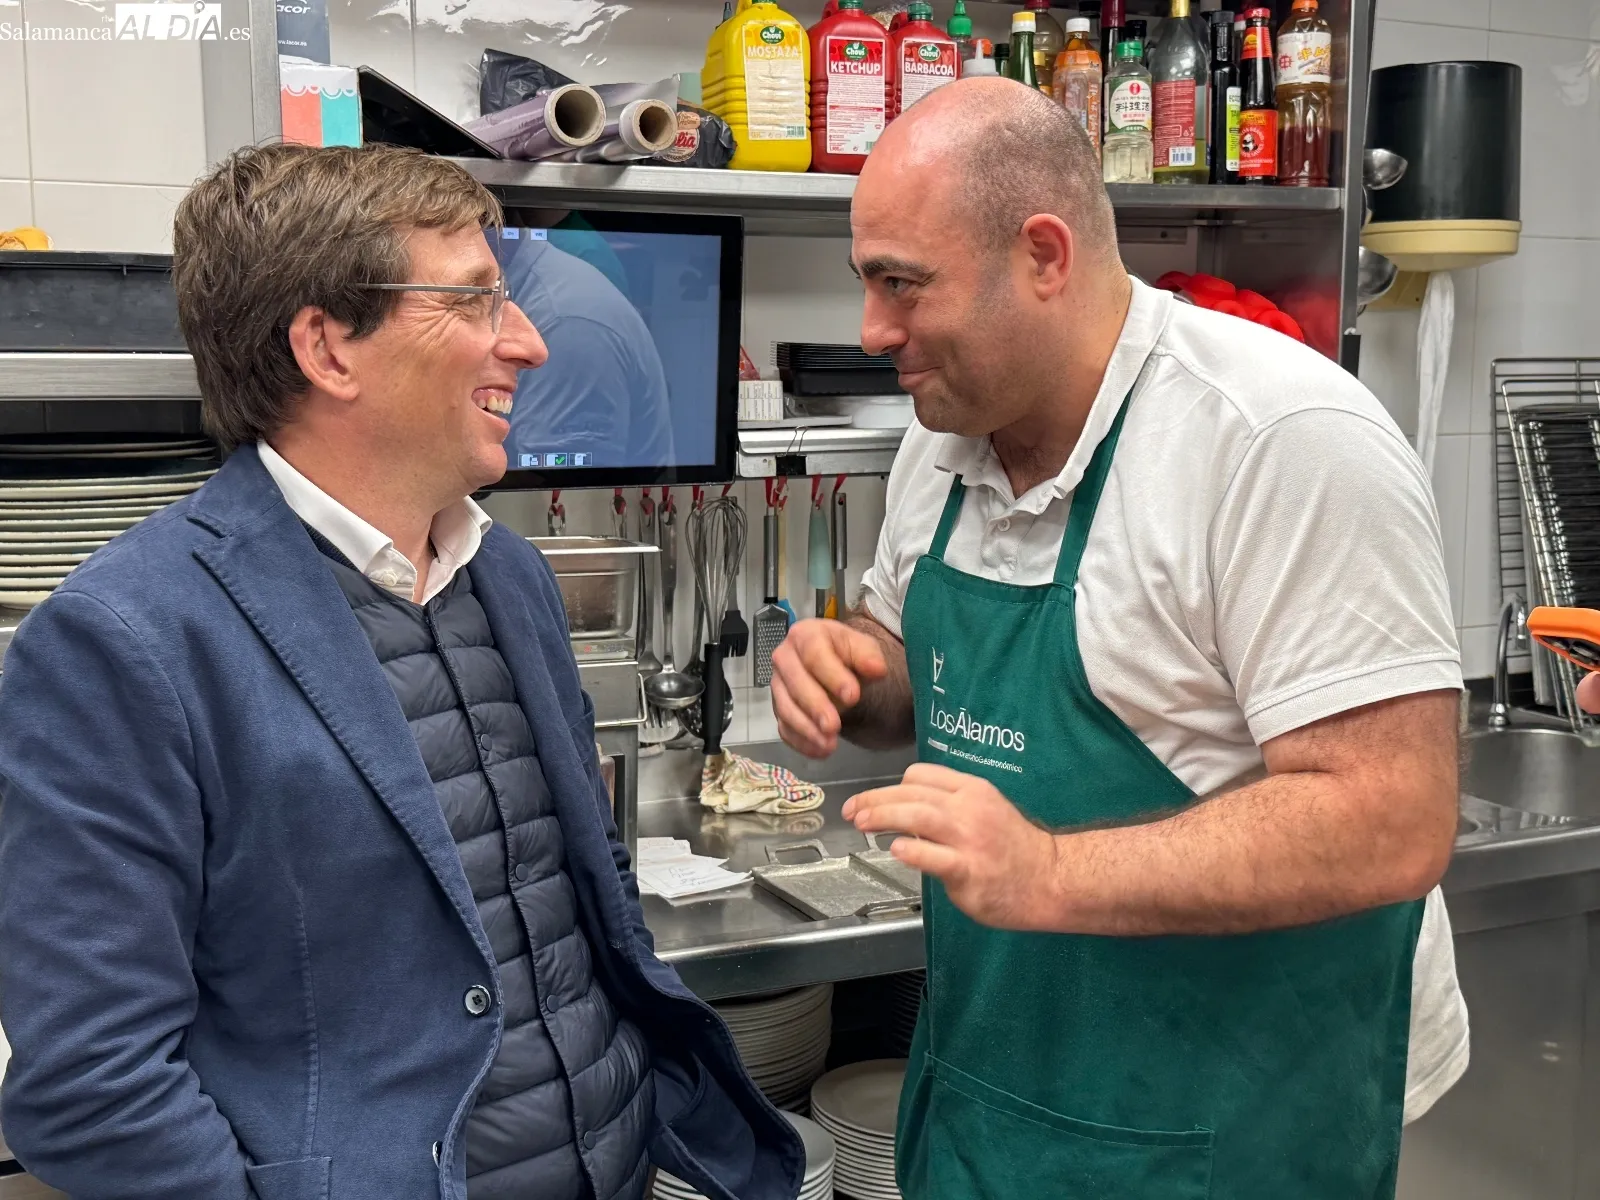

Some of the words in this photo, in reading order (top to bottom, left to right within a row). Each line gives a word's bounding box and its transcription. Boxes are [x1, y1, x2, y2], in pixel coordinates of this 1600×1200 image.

[277, 4, 311, 14] acor
[747, 46, 799, 57] MOSTAZA
[830, 61, 881, 75] KETCHUP
[904, 62, 954, 76] BARBACOA
